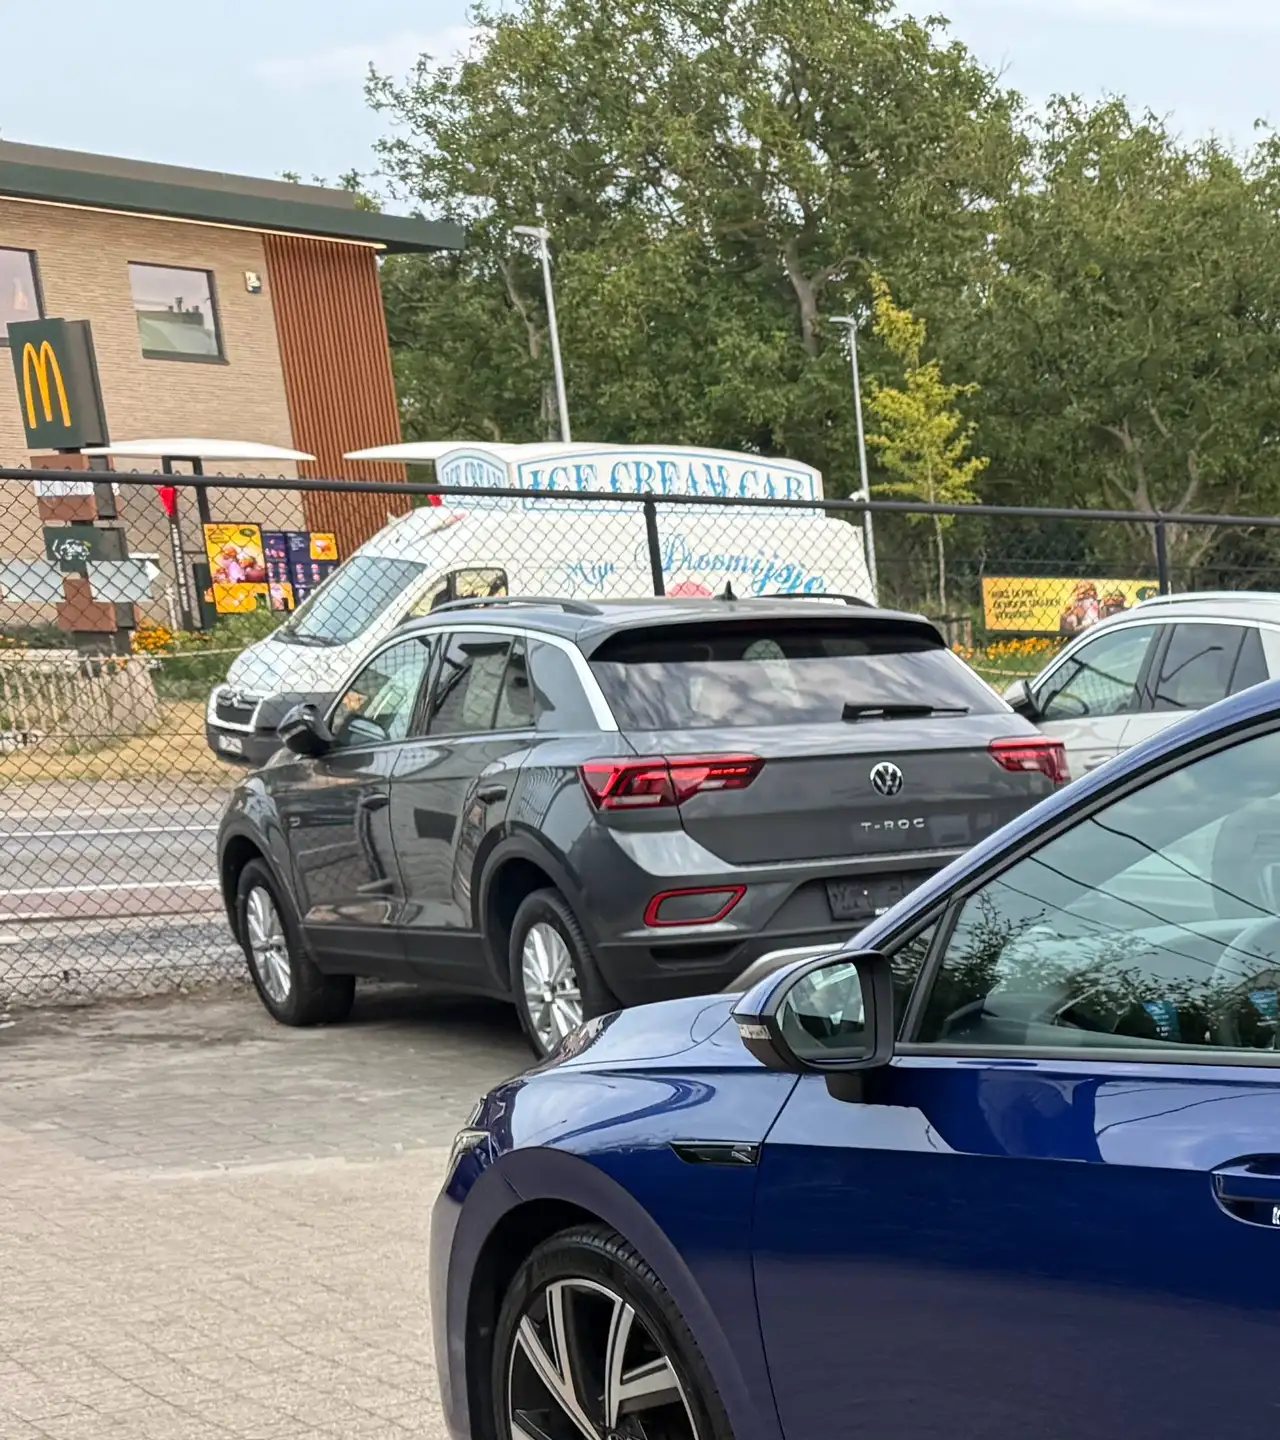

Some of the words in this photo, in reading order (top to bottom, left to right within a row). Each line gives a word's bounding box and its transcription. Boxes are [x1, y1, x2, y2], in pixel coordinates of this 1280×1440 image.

[529, 464, 598, 492] ICE
[610, 461, 731, 497] CREAM
[861, 818, 925, 832] T-ROC
